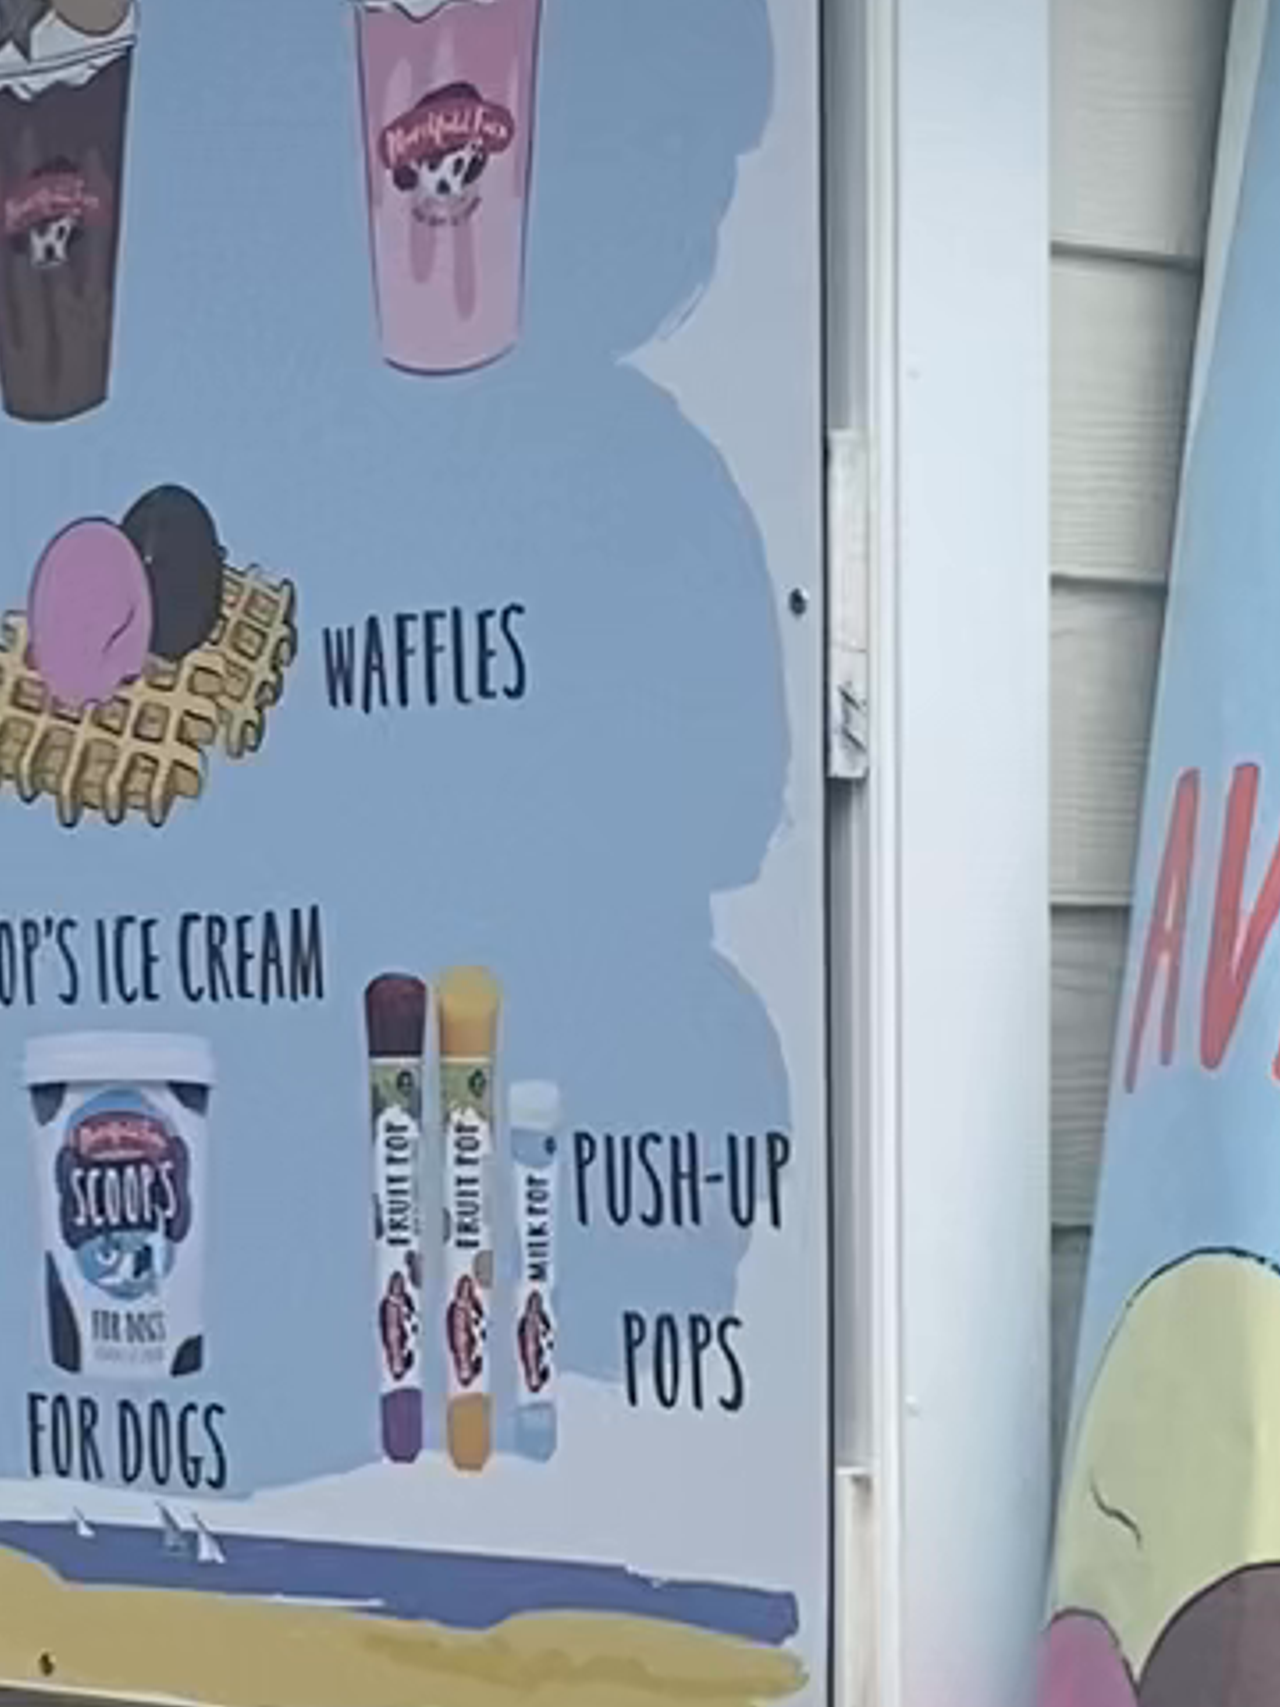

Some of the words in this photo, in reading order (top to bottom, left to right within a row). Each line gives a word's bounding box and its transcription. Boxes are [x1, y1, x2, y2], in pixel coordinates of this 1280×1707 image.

[323, 605, 527, 714] WAFFLES
[95, 913, 161, 1005] ICE
[179, 905, 324, 1006] CREAM
[575, 1130, 792, 1230] PUSH-UP
[622, 1312, 744, 1411] POPS
[26, 1392, 103, 1480] FOR
[120, 1399, 227, 1490] DOGS
